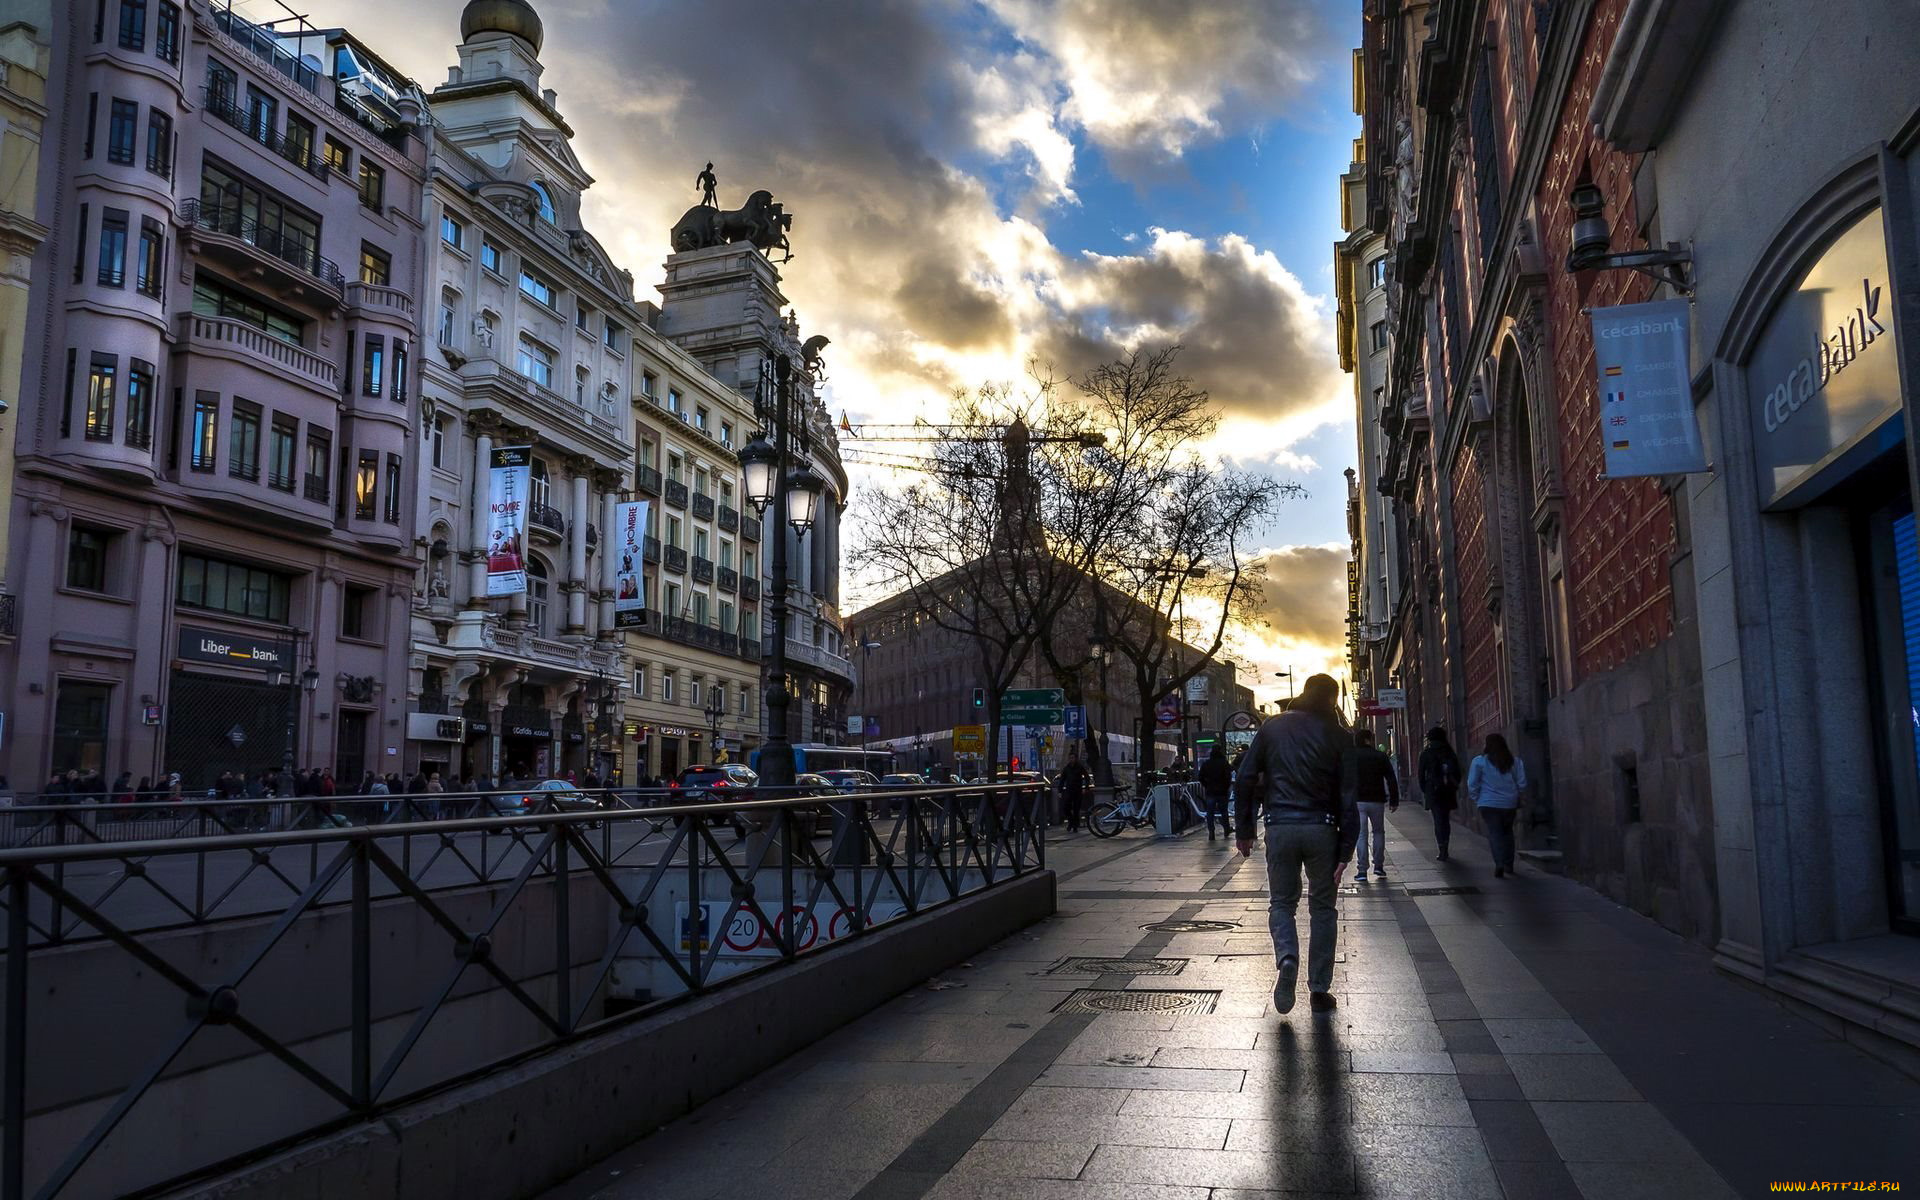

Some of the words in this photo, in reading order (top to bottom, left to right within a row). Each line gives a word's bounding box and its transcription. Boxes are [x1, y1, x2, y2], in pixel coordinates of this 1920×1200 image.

[1601, 317, 1684, 339] cecabank
[1764, 278, 1885, 433] cecabank
[626, 506, 638, 545] NOMBRE
[1348, 562, 1357, 612] HOTEL
[201, 639, 230, 655] Liber
[1069, 711, 1079, 723] P
[732, 919, 755, 937] 20
